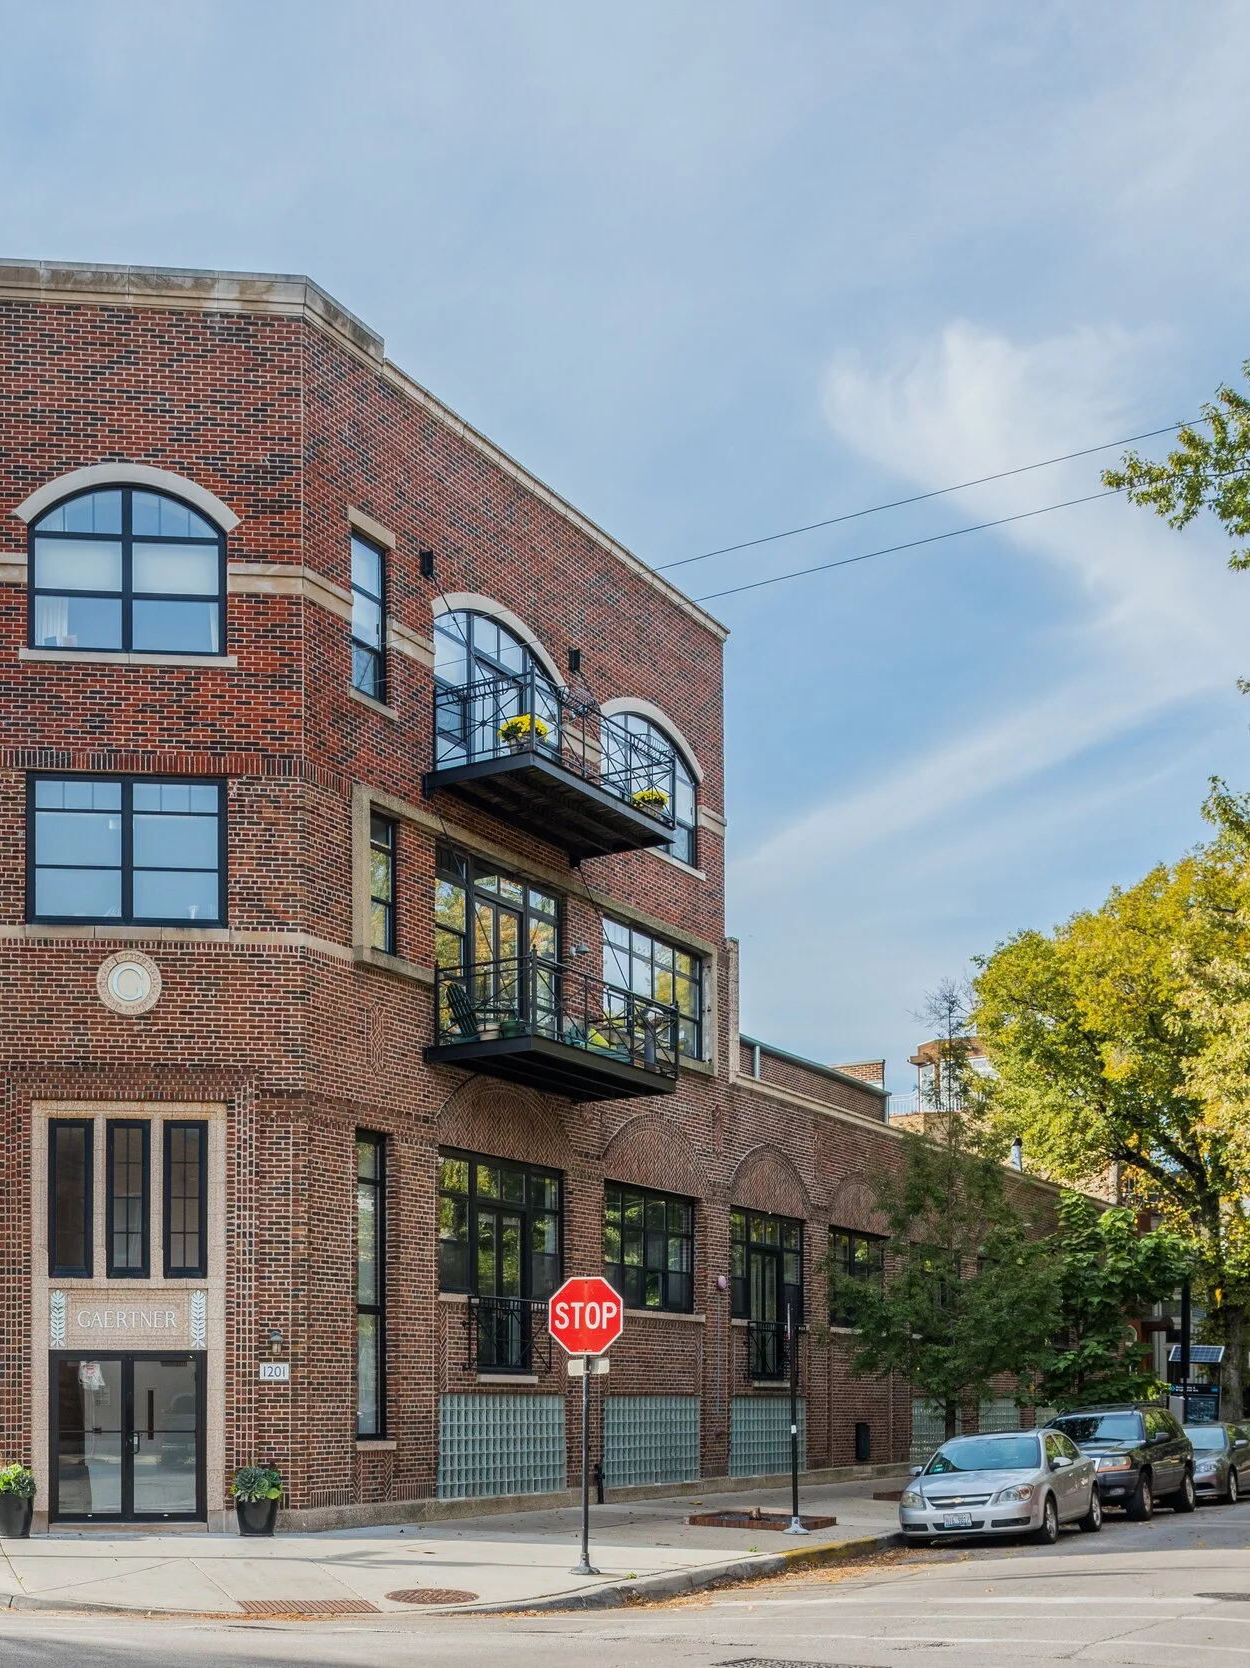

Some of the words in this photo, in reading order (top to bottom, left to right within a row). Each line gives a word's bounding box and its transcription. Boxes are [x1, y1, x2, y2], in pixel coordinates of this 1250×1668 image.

[77, 1310, 178, 1328] GAERTNER
[554, 1301, 617, 1330] STOP
[263, 1366, 285, 1377] 1201
